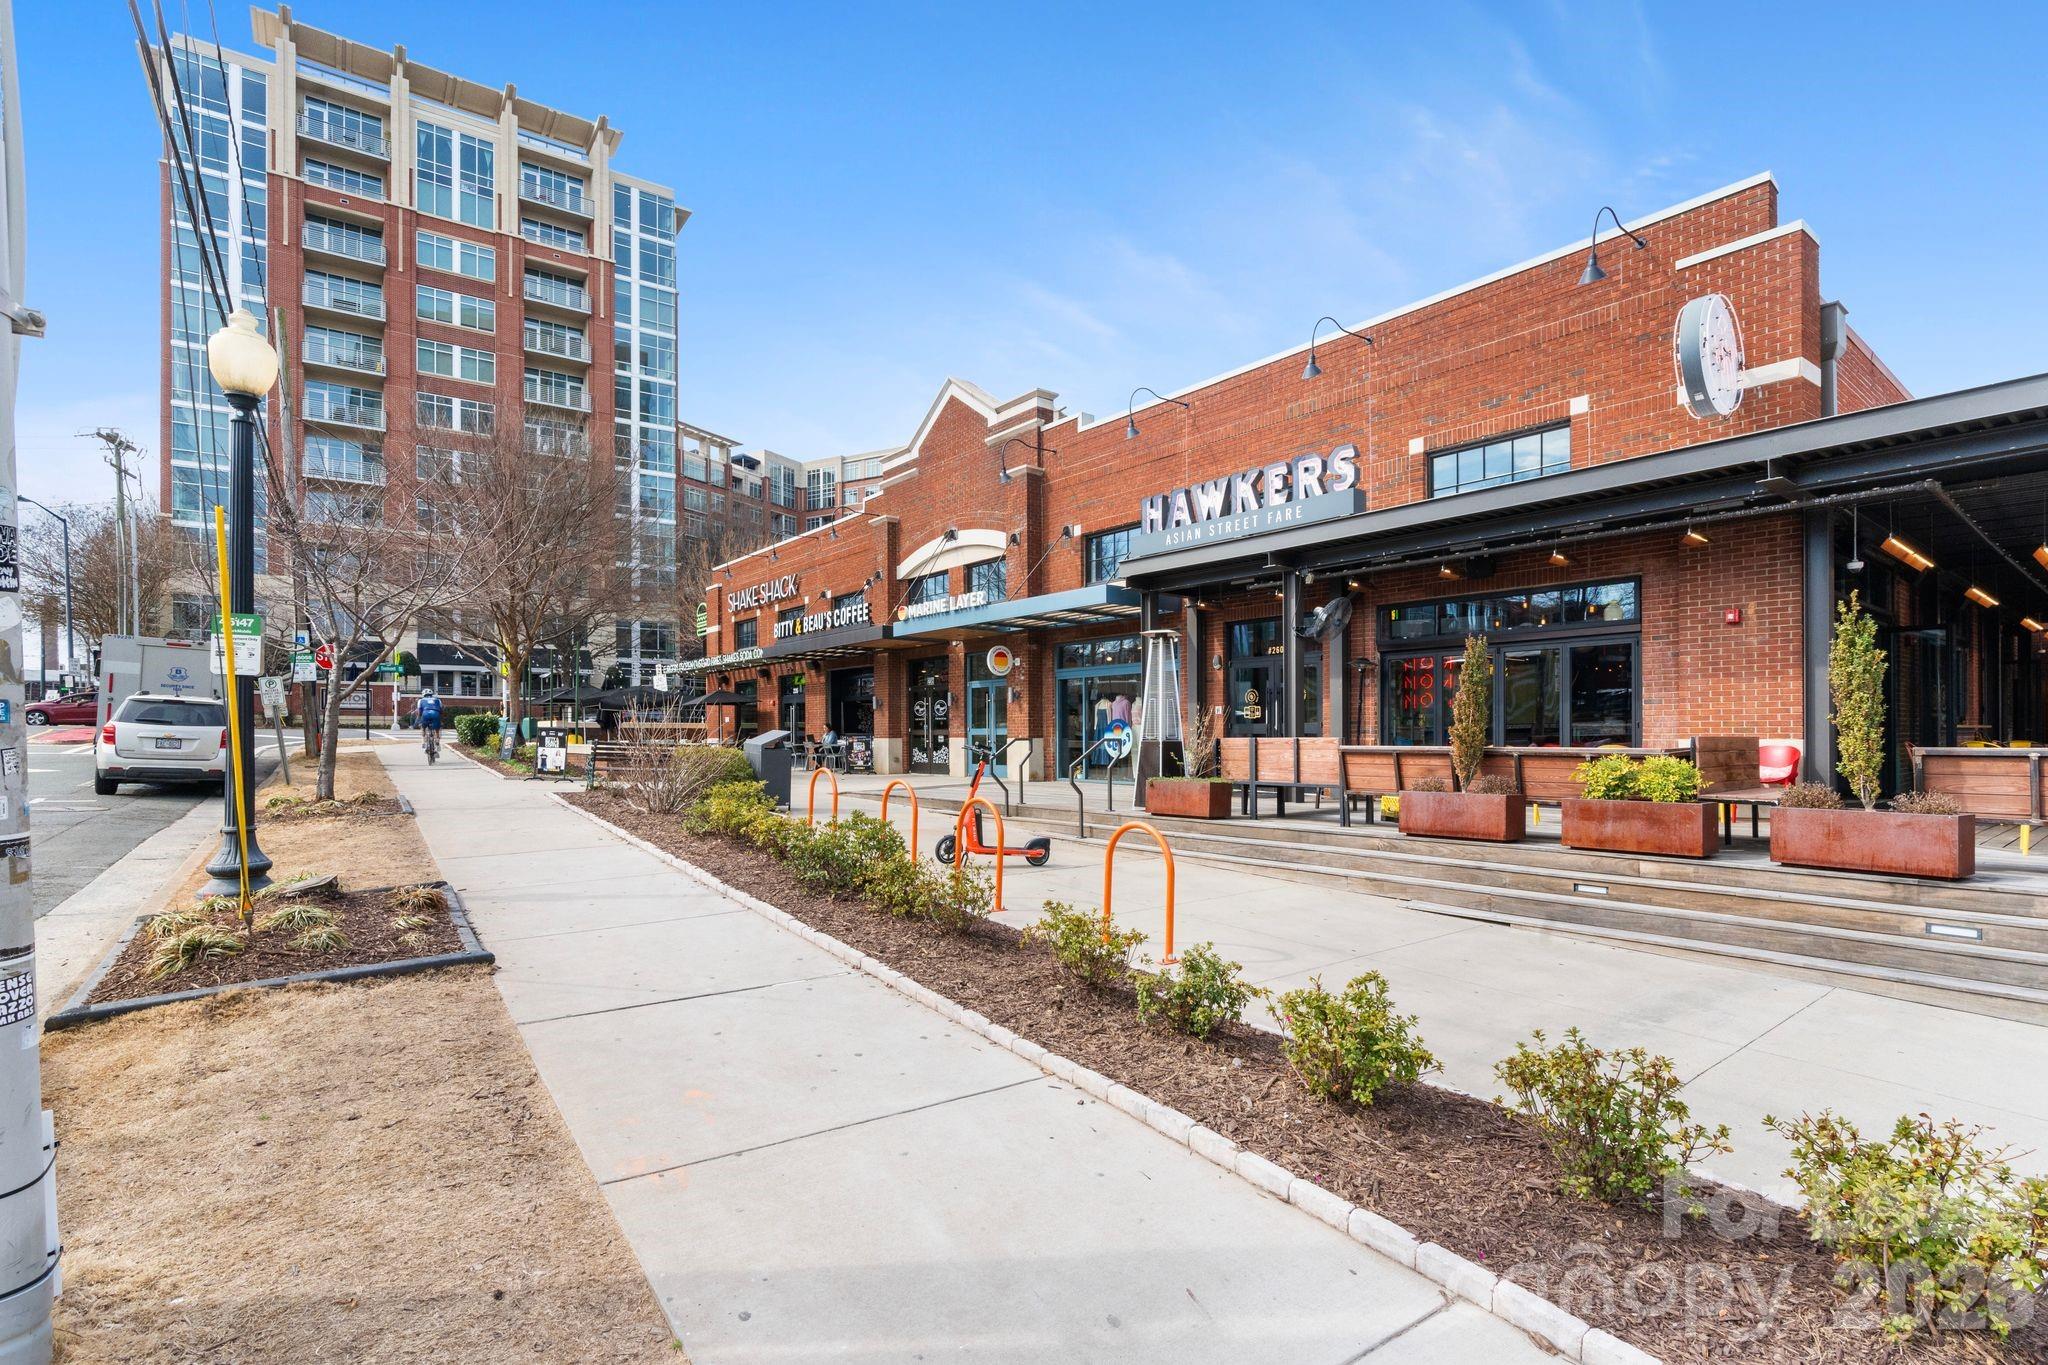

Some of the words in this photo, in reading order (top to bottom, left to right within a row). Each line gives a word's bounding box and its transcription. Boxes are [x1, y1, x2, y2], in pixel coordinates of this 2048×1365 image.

[1141, 444, 1359, 535] HAWKERS
[1165, 528, 1201, 546] ASIAN
[1209, 514, 1258, 538] STREET
[1267, 505, 1303, 525] FARE
[728, 585, 759, 613] SHAKE
[760, 573, 797, 605] SHACK
[908, 598, 949, 619] MARINE
[949, 590, 987, 611] LAYER
[773, 619, 794, 639] BITTY
[795, 617, 802, 636] &
[803, 611, 832, 633] BEAU'S
[833, 602, 869, 627] COFFEE
[1404, 673, 1434, 690] NO
[1404, 692, 1434, 709] NO
